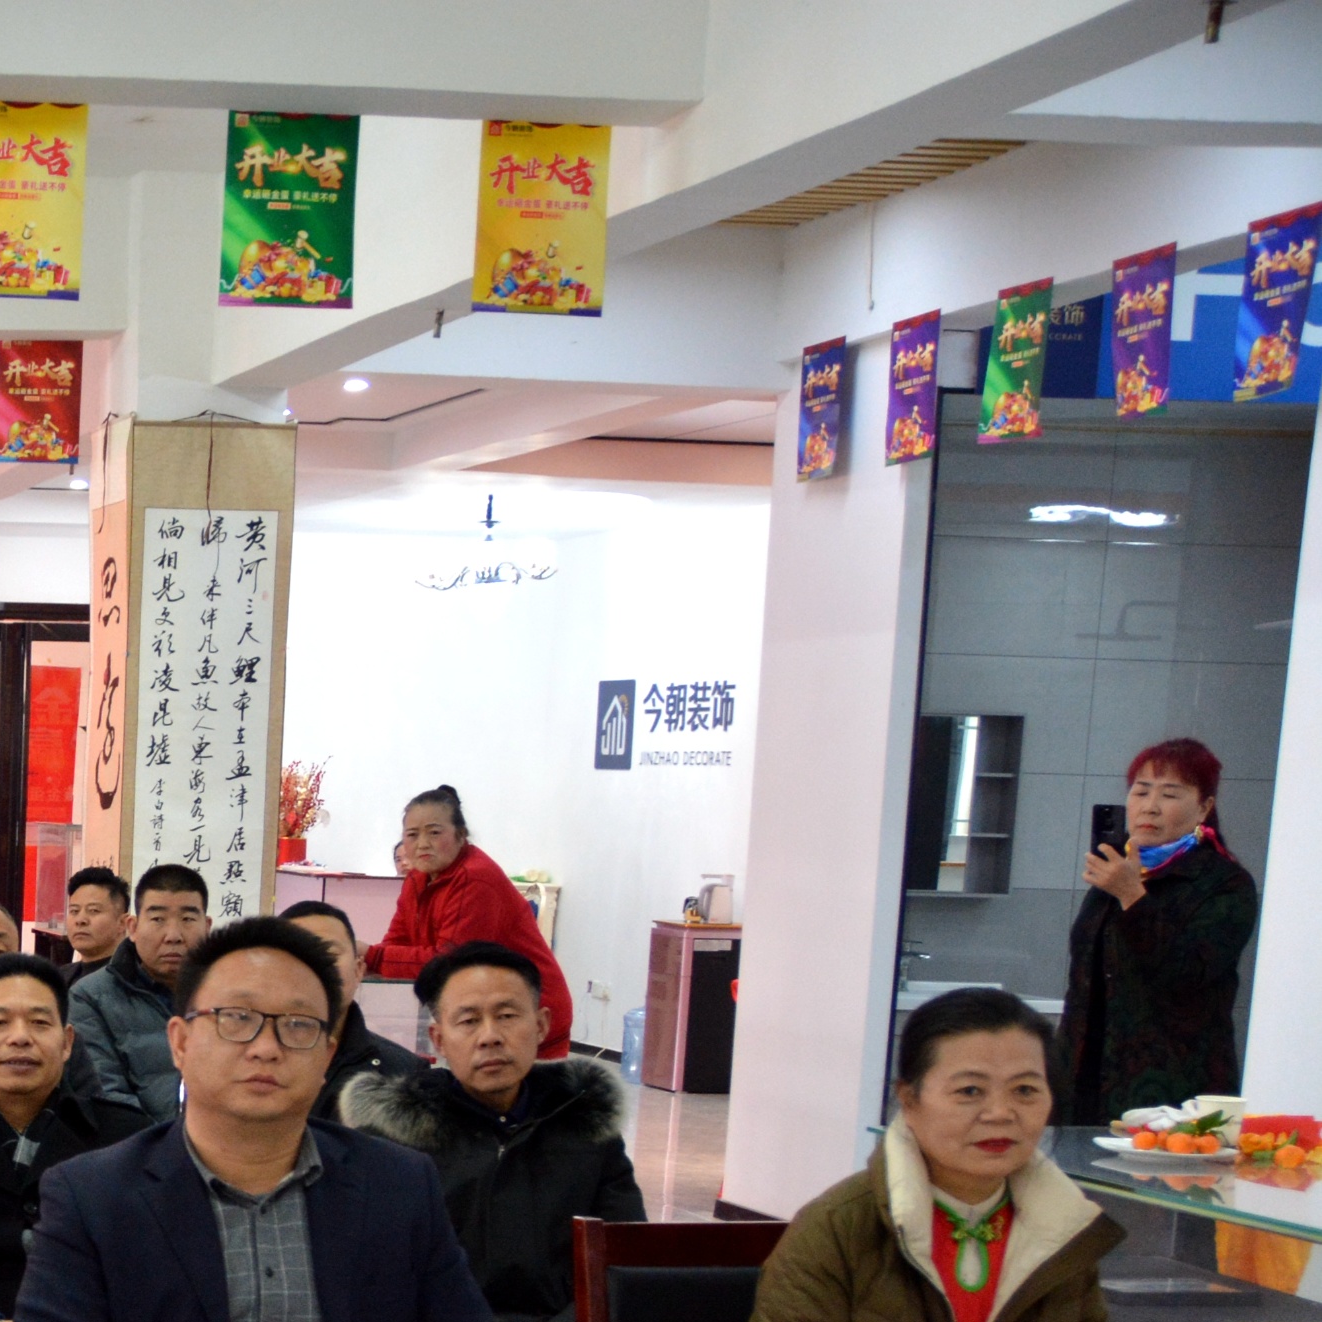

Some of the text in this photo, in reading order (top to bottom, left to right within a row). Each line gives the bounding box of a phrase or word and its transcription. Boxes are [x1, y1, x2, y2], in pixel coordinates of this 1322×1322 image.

[236, 143, 347, 189] 开业大吉
[489, 152, 597, 197] 开业大吉
[3, 359, 74, 388] 开业大吉
[643, 680, 736, 733] 今朝装饰
[639, 751, 732, 766] JINZHAO DECORATE
